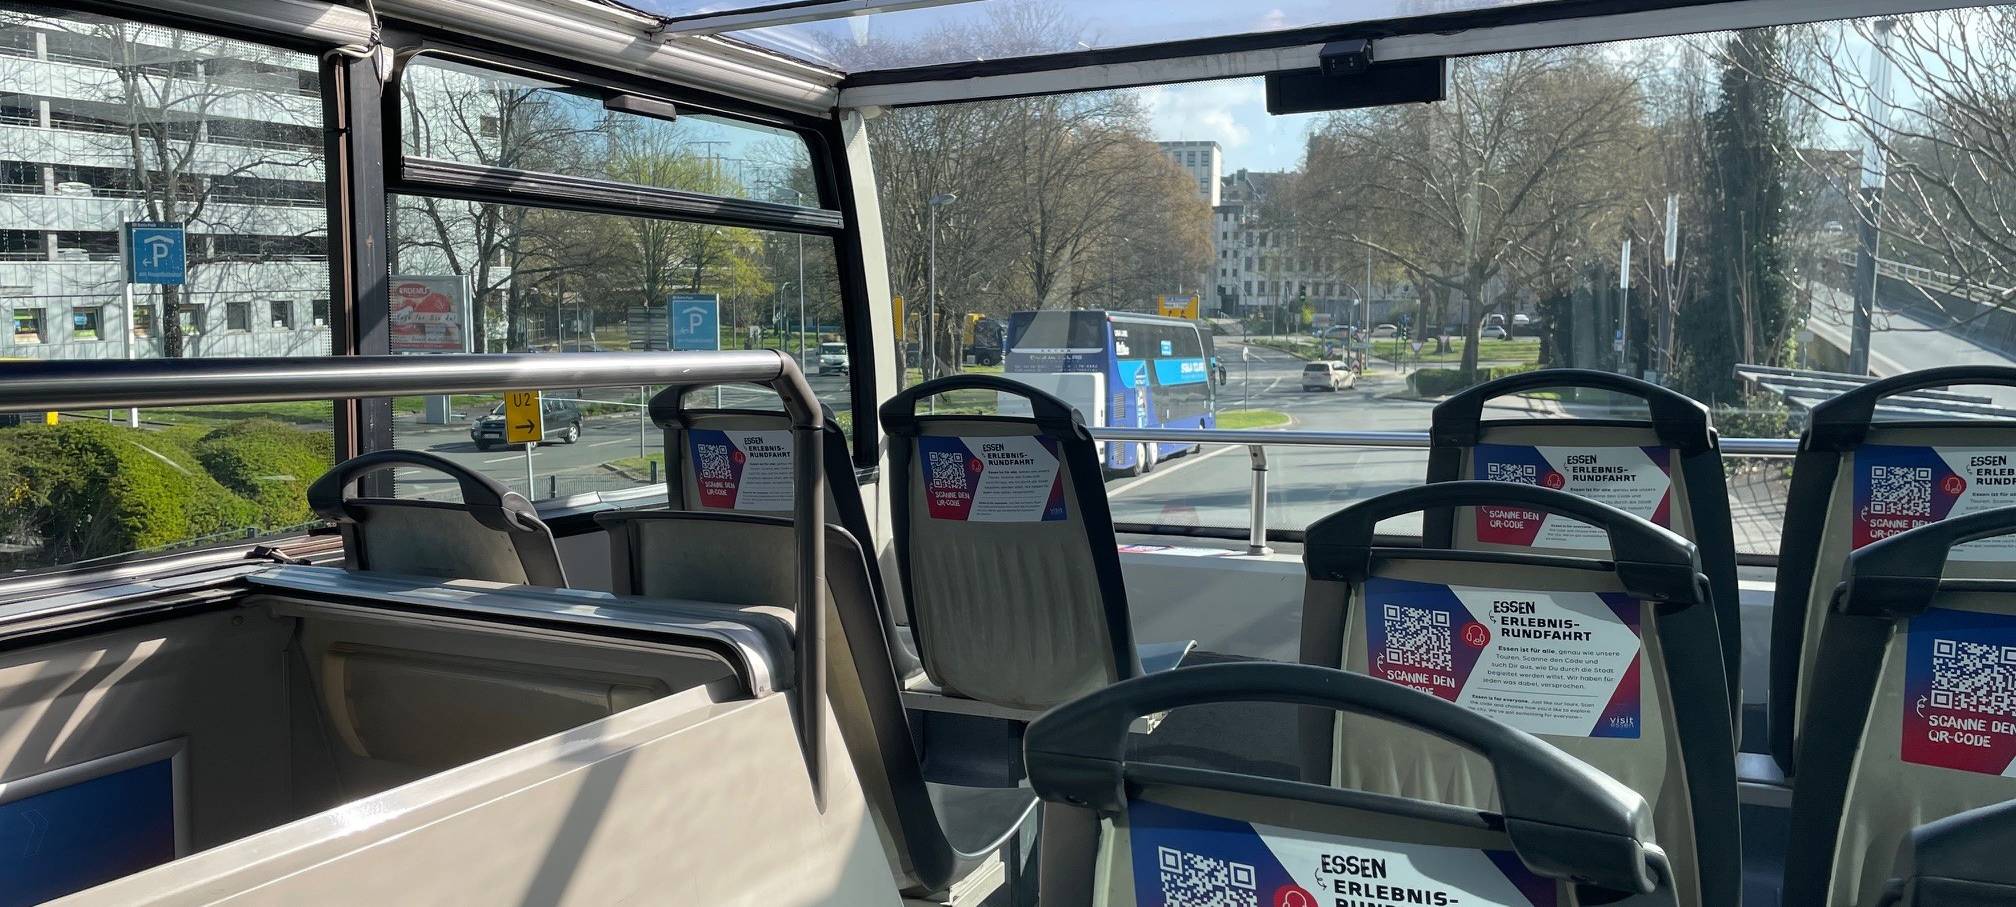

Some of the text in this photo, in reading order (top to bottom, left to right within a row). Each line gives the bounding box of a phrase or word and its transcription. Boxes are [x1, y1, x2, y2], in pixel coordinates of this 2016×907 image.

[744, 436, 763, 445] ESSEN
[982, 443, 1005, 452] ESSEN
[1566, 454, 1597, 465] ESSEN
[1970, 455, 2007, 467] ESSEN
[1572, 466, 1629, 474] ERLEBNIS-
[1572, 474, 1638, 482] RUNDFAHRT
[1489, 510, 1540, 521] SCANNE DEN
[1489, 520, 1524, 530] QR-CODE
[1869, 519, 1909, 529] SCANNE
[1493, 600, 1536, 614] ESSEN
[1501, 616, 1580, 629] ERLEBNIS-
[1501, 628, 1592, 642] RUNDFAHRT
[1498, 645, 1519, 653] Essen
[1387, 670, 1456, 689] SCANNE DEN
[1609, 714, 1634, 724] visit
[1928, 714, 1987, 732] SCANNE
[1928, 729, 1992, 748] QR-CODE
[1321, 854, 1387, 879] ESSEN
[1334, 879, 1459, 907] ERLEBNIS-
